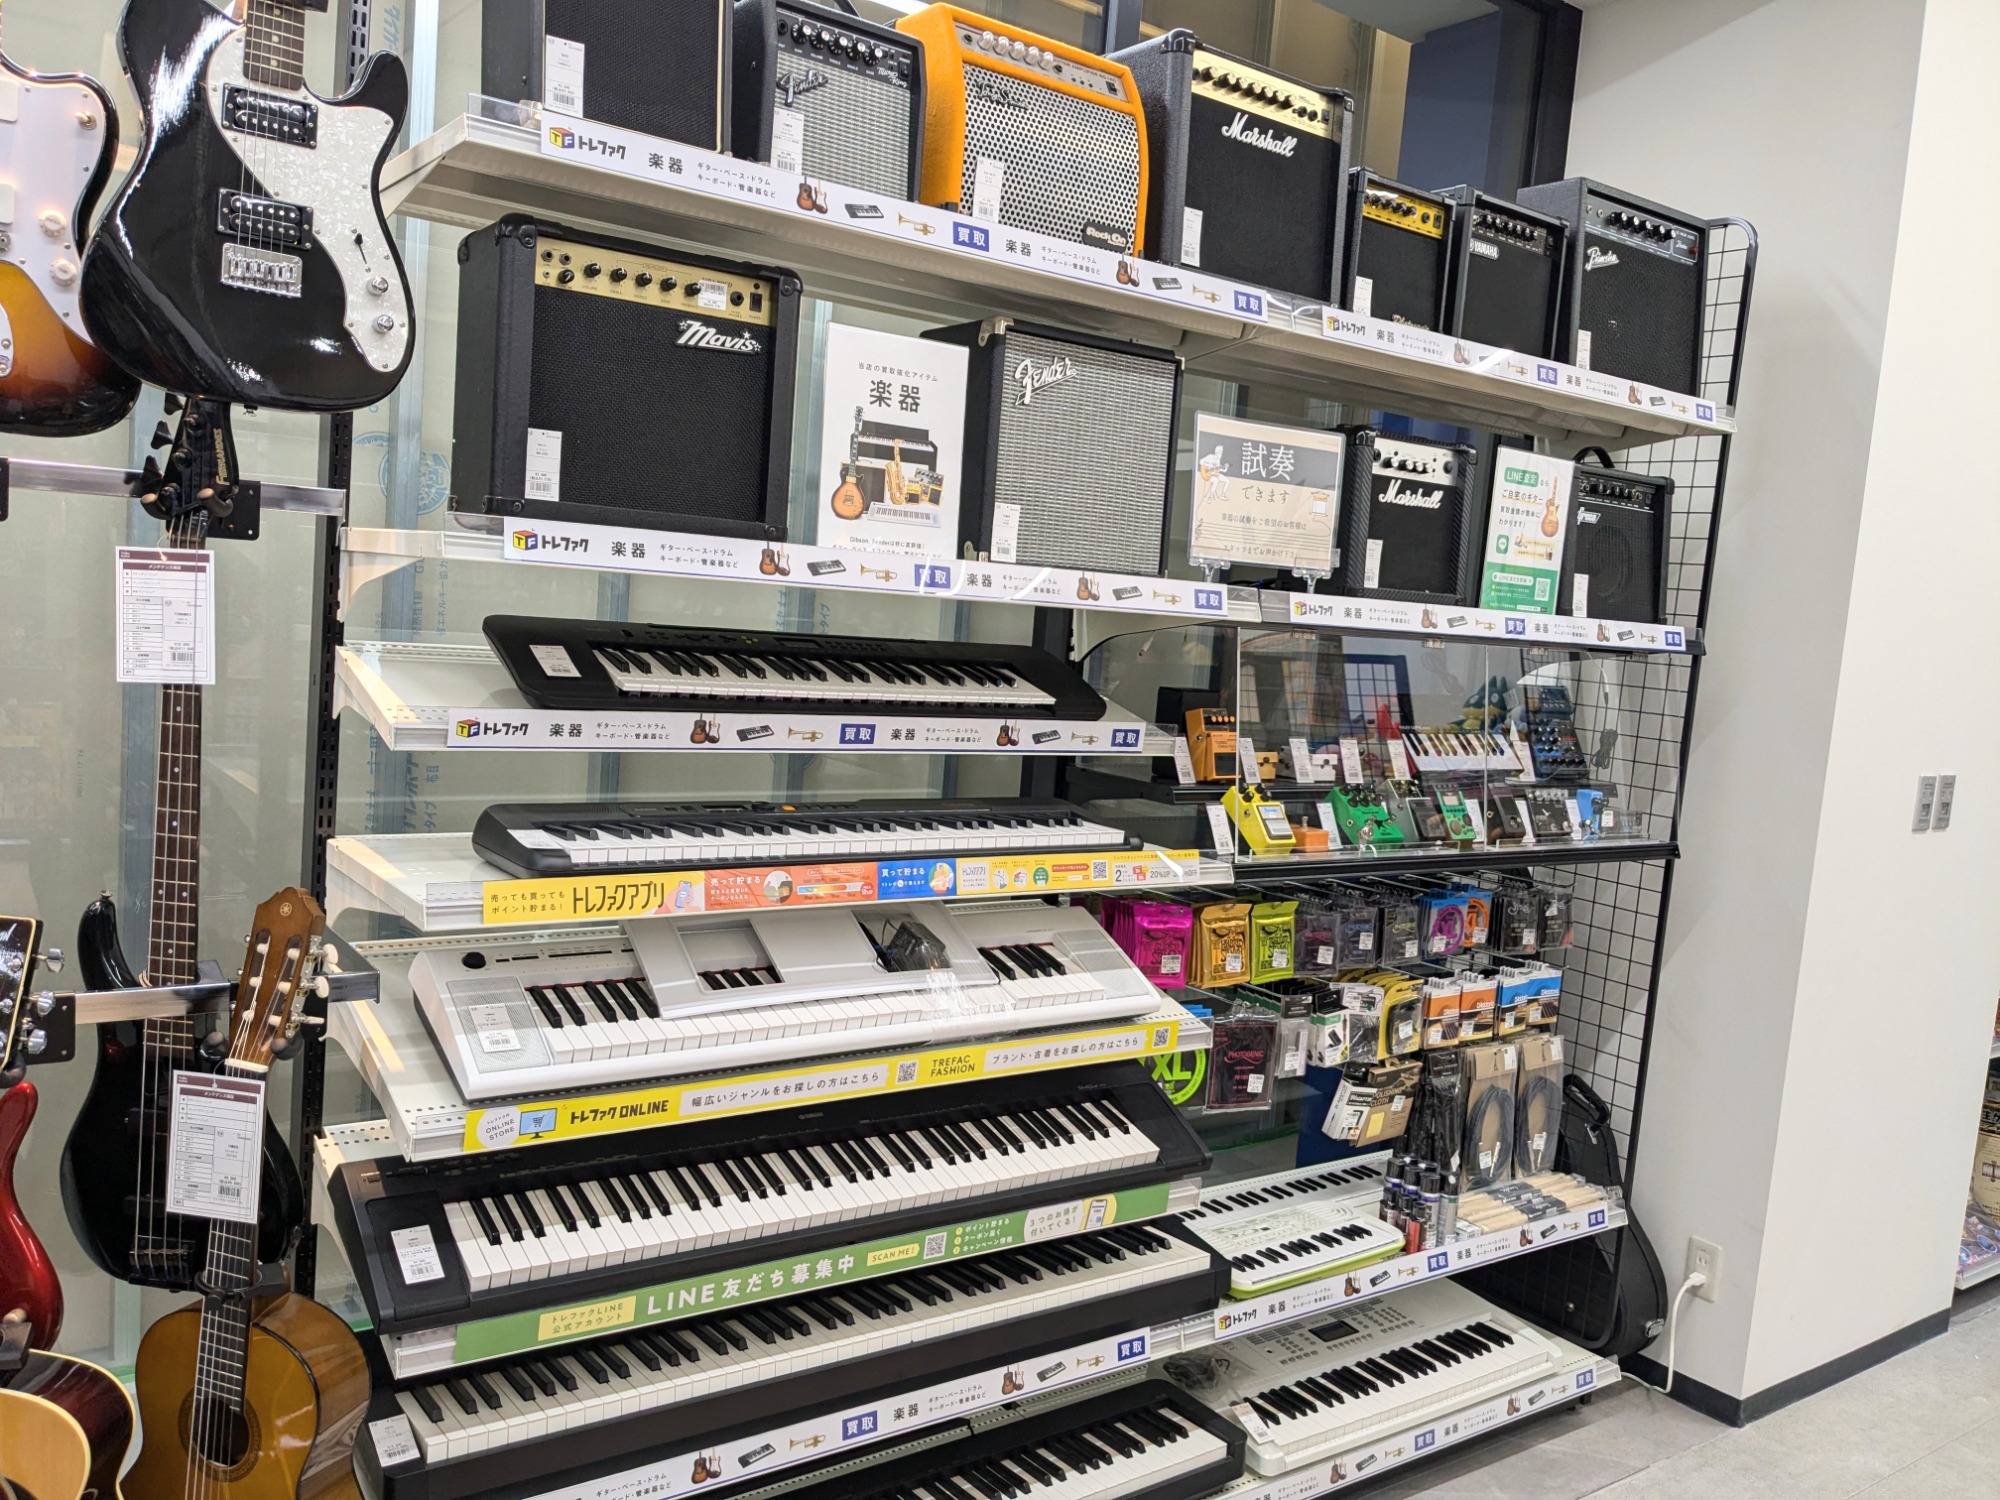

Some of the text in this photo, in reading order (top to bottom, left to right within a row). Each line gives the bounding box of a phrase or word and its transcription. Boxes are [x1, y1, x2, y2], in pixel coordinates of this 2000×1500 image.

[1221, 112, 1297, 157] Marshall
[578, 135, 626, 160] トレファク
[648, 152, 683, 174] 楽器
[698, 161, 771, 185] ギター・ベース・ドラム
[698, 173, 776, 198] キーボード・管楽器など
[957, 227, 986, 247] 買取
[1086, 227, 1128, 245] Rock On
[1005, 239, 1032, 257] 楽器
[1041, 246, 1097, 264] ギター・ベース・ドラム
[1474, 240, 1498, 259] YAMAHA
[1041, 255, 1101, 275] キーボード・管楽器など
[1237, 295, 1260, 312] 買取
[676, 320, 756, 352] Mavis
[1341, 320, 1366, 336] トレファク
[1376, 329, 1395, 344] 楽器
[858, 361, 938, 382] 当店の買取強化アイテム
[1539, 367, 1556, 381] 買取
[1015, 356, 1077, 406] Fender
[869, 379, 921, 414] 楽器
[213, 428, 230, 485] FERNANDES
[1241, 441, 1295, 481] 試奏
[1507, 470, 1537, 486] LINE査定
[1242, 485, 1290, 504] できます
[1378, 479, 1444, 509] Marshall
[1501, 489, 1544, 503] ご自宅のギター
[541, 534, 589, 553] トレファク
[611, 541, 646, 559] 楽器
[659, 543, 733, 557] ギター・ベース・ドラム
[659, 555, 739, 569] キーボード・管楽器など
[919, 569, 947, 585] 買取
[966, 573, 993, 588] 楽器
[1197, 592, 1220, 607] 買取
[1308, 605, 1334, 617] トレファク
[1343, 606, 1363, 620] 楽器
[1506, 619, 1524, 633] 買取
[483, 722, 529, 736] トレファク
[549, 723, 583, 738] 楽器
[596, 722, 667, 731] ギター・ベース・ドラム
[843, 726, 871, 741] 買取
[926, 727, 980, 735] ギター・ベース・ドラム
[595, 732, 671, 741] キーボード・管楽器など
[890, 728, 916, 742] 楽器
[924, 735, 982, 743] キーボード・管楽器など
[1115, 732, 1137, 745] 買取
[881, 867, 925, 877] 買って貯まる
[1115, 869, 1122, 882] 2
[710, 875, 761, 887] 売って貯まる
[490, 891, 566, 903] 売っても買っても
[572, 880, 665, 915] トレファクアプリ
[491, 903, 564, 915] ポイント貯まる!
[993, 1038, 1139, 1064] ブランド・古着をお探しの方はこちら
[1228, 1050, 1265, 1059] PHOTOGENIC
[932, 1054, 970, 1067] TREFAC
[931, 1064, 975, 1077] FASHION
[692, 1071, 879, 1107] 幅広いジャンルをお探しの方はこちら
[1370, 1097, 1390, 1107] CLOTH
[485, 1118, 515, 1134] ONLINE
[486, 1113, 511, 1125] トレファクの
[489, 1127, 515, 1141] STORE
[1030, 1204, 1079, 1228] 3つのお得が
[1589, 1211, 1604, 1224] 買取
[965, 1216, 1010, 1233] ポイント貯まる
[1030, 1216, 1077, 1237] 付いてくる!
[962, 1236, 1013, 1252] キャンペーン情報
[872, 1250, 896, 1262] SCAN
[1430, 1255, 1447, 1270] 買取
[552, 1302, 624, 1324] トレファクLINE
[1233, 1308, 1258, 1324] トレファク
[1268, 1300, 1286, 1316] 楽器
[552, 1312, 623, 1334] 公式アカウント
[1120, 1340, 1143, 1358] 買取
[1577, 1370, 1594, 1386] 買取
[928, 1384, 983, 1404] ギター・ベース・ドラム
[928, 1391, 987, 1414] キーボード・管楽器など
[893, 1402, 920, 1422] 楽器
[846, 1415, 874, 1436] 買取
[1444, 1423, 1459, 1437] 楽器
[1416, 1432, 1434, 1449] 買取
[596, 1472, 667, 1498] ギター・ベース・ドラム
